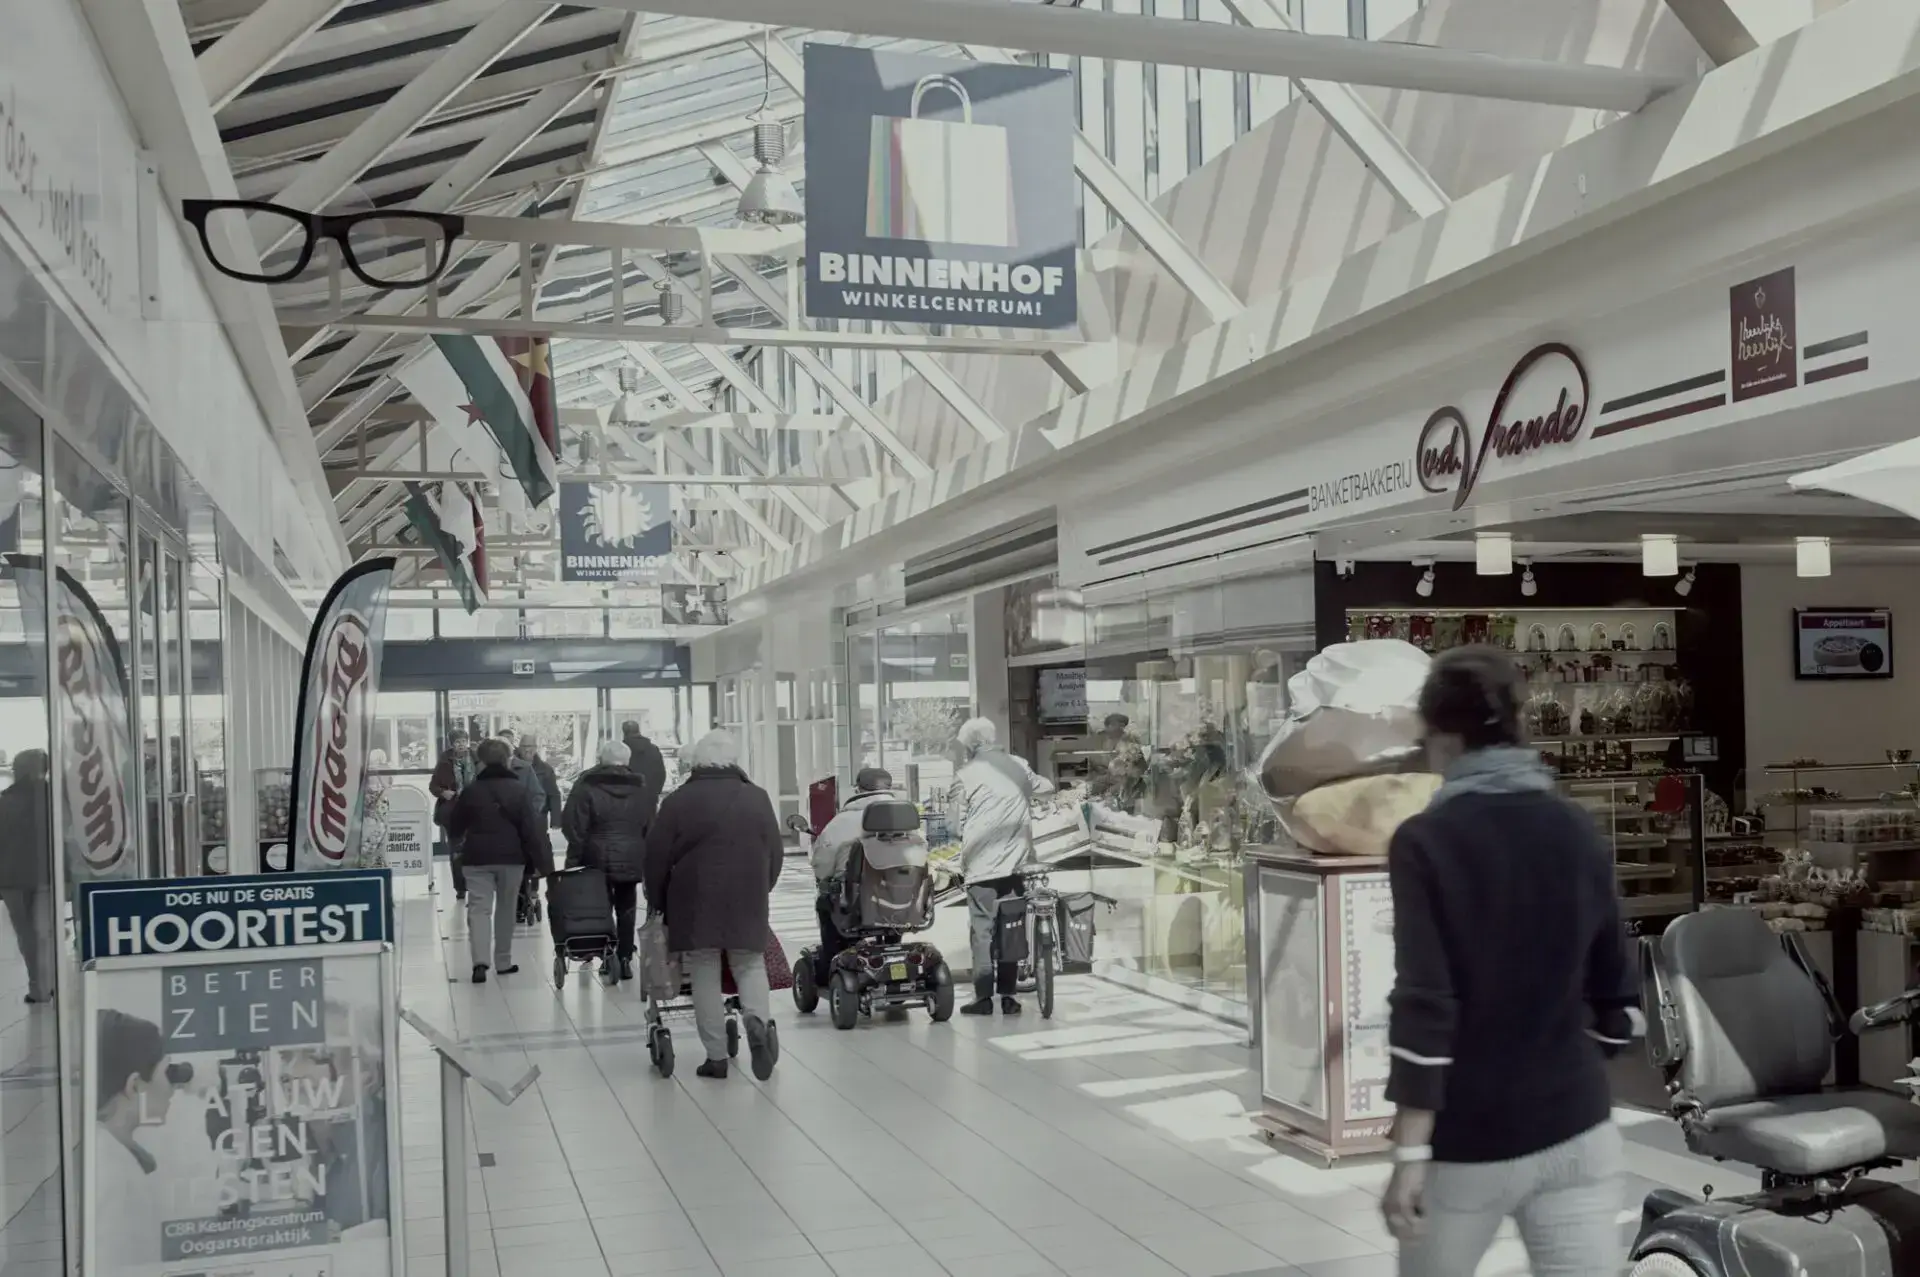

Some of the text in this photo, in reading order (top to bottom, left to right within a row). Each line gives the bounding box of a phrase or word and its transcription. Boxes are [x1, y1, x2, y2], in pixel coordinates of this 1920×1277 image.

[819, 251, 1063, 296] BINNENHOF
[841, 290, 1042, 316] WINKELCENTRUM!
[1310, 459, 1412, 512] BANKETBAKKERIJ
[386, 842, 421, 852] chnitzels
[165, 886, 315, 906] DOE NU DE GRATIS
[108, 903, 370, 955] HOORTEST
[170, 967, 316, 996] BETER
[170, 1000, 318, 1039] ZIEN
[138, 1082, 257, 1125] LAT
[195, 1120, 308, 1163] GEN
